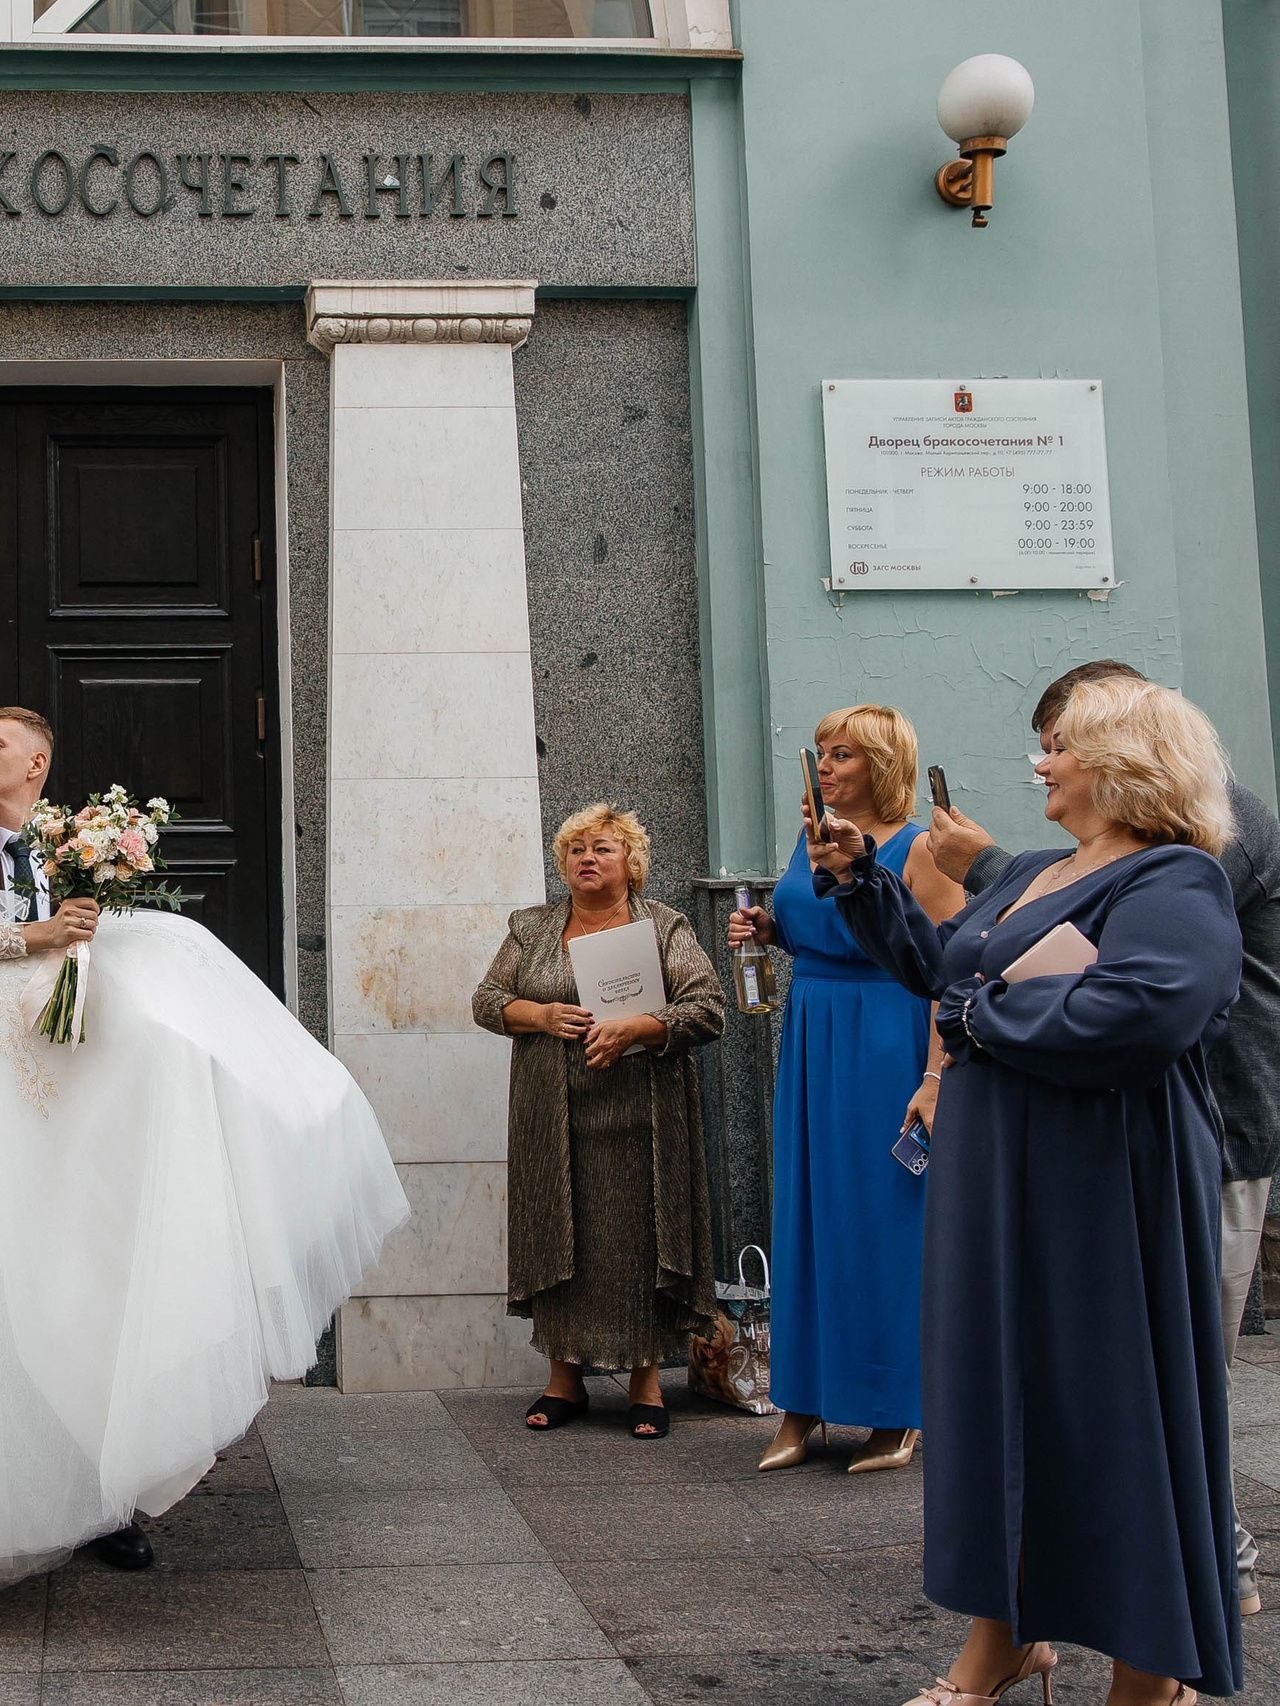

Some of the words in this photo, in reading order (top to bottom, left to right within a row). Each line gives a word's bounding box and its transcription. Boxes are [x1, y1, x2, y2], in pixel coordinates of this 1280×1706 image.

[868, 435, 920, 449] Дворец
[923, 434, 1033, 449] бракосочетания
[1037, 435, 1054, 446] №
[1058, 435, 1064, 446] 1
[921, 467, 965, 477] РЕЖИМ
[969, 467, 1015, 477] РАБОТЫ
[1022, 484, 1049, 494] 9:00
[1061, 484, 1091, 494] 18:00
[1024, 502, 1050, 512] 9:00
[1060, 502, 1093, 512] 20:00
[1025, 520, 1051, 530] 9:00
[1061, 520, 1094, 530] 23:59
[1018, 538, 1052, 548] 00:00
[1064, 538, 1095, 548] 19:00
